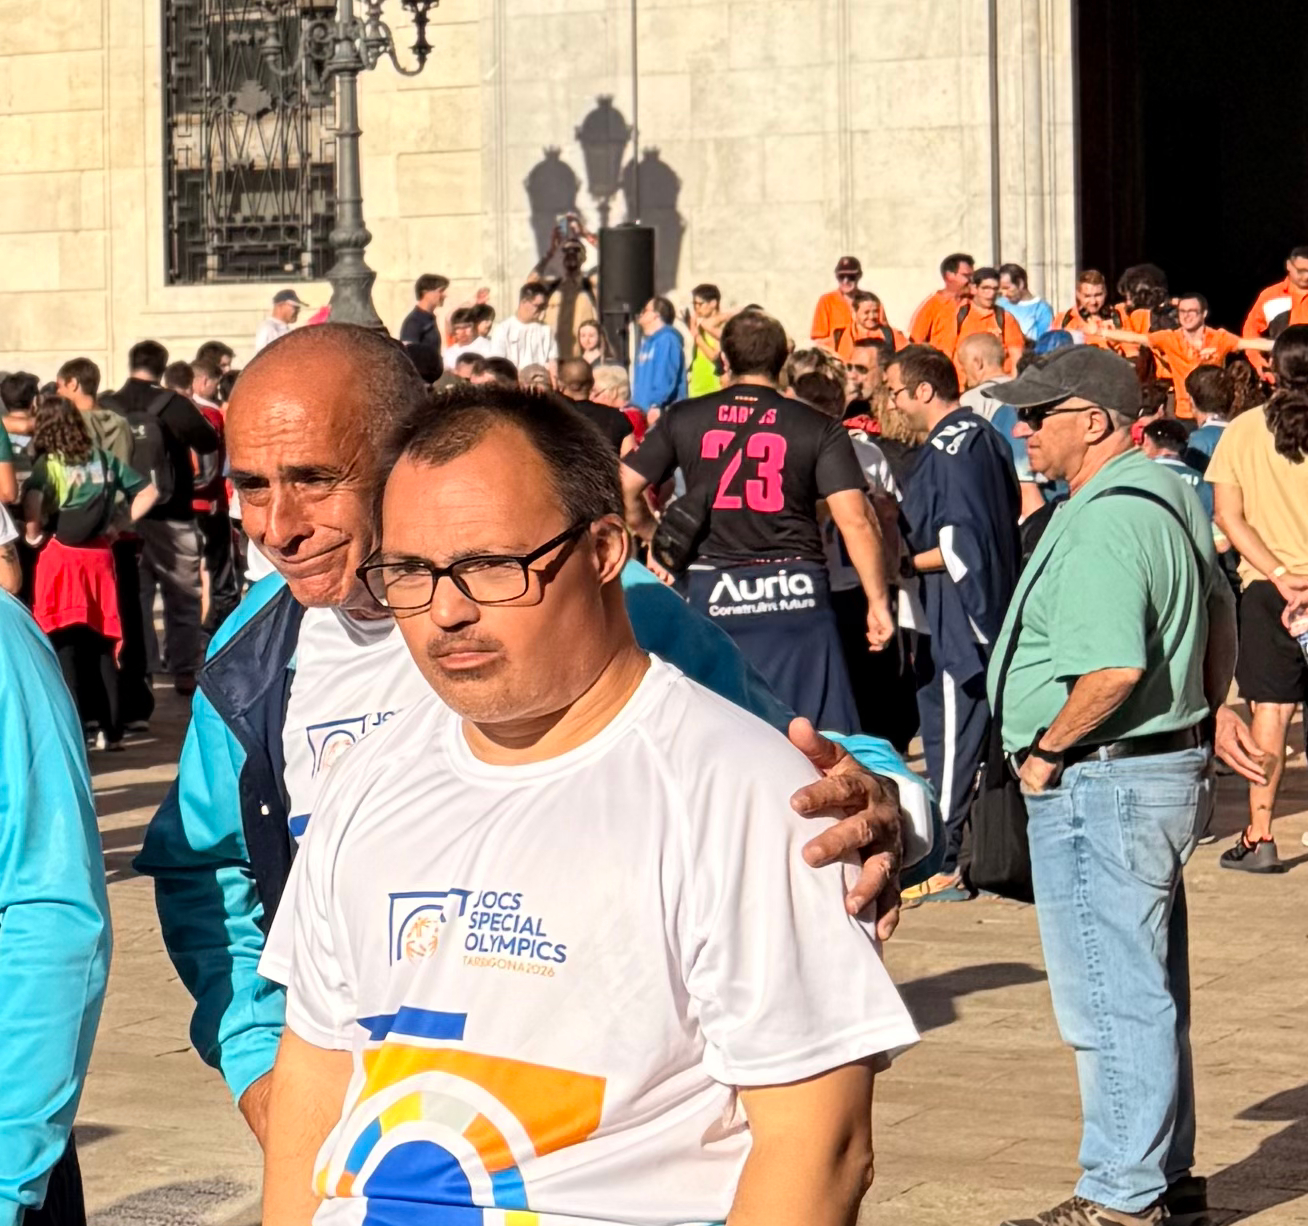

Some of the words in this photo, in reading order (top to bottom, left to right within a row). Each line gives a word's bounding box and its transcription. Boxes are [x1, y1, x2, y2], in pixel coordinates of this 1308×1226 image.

[718, 404, 777, 424] CARS
[700, 429, 788, 512] 23
[709, 569, 815, 603] Auria
[472, 889, 524, 911] JOCS
[468, 911, 547, 938] SPECIAL
[464, 932, 568, 964] OLYMPICS
